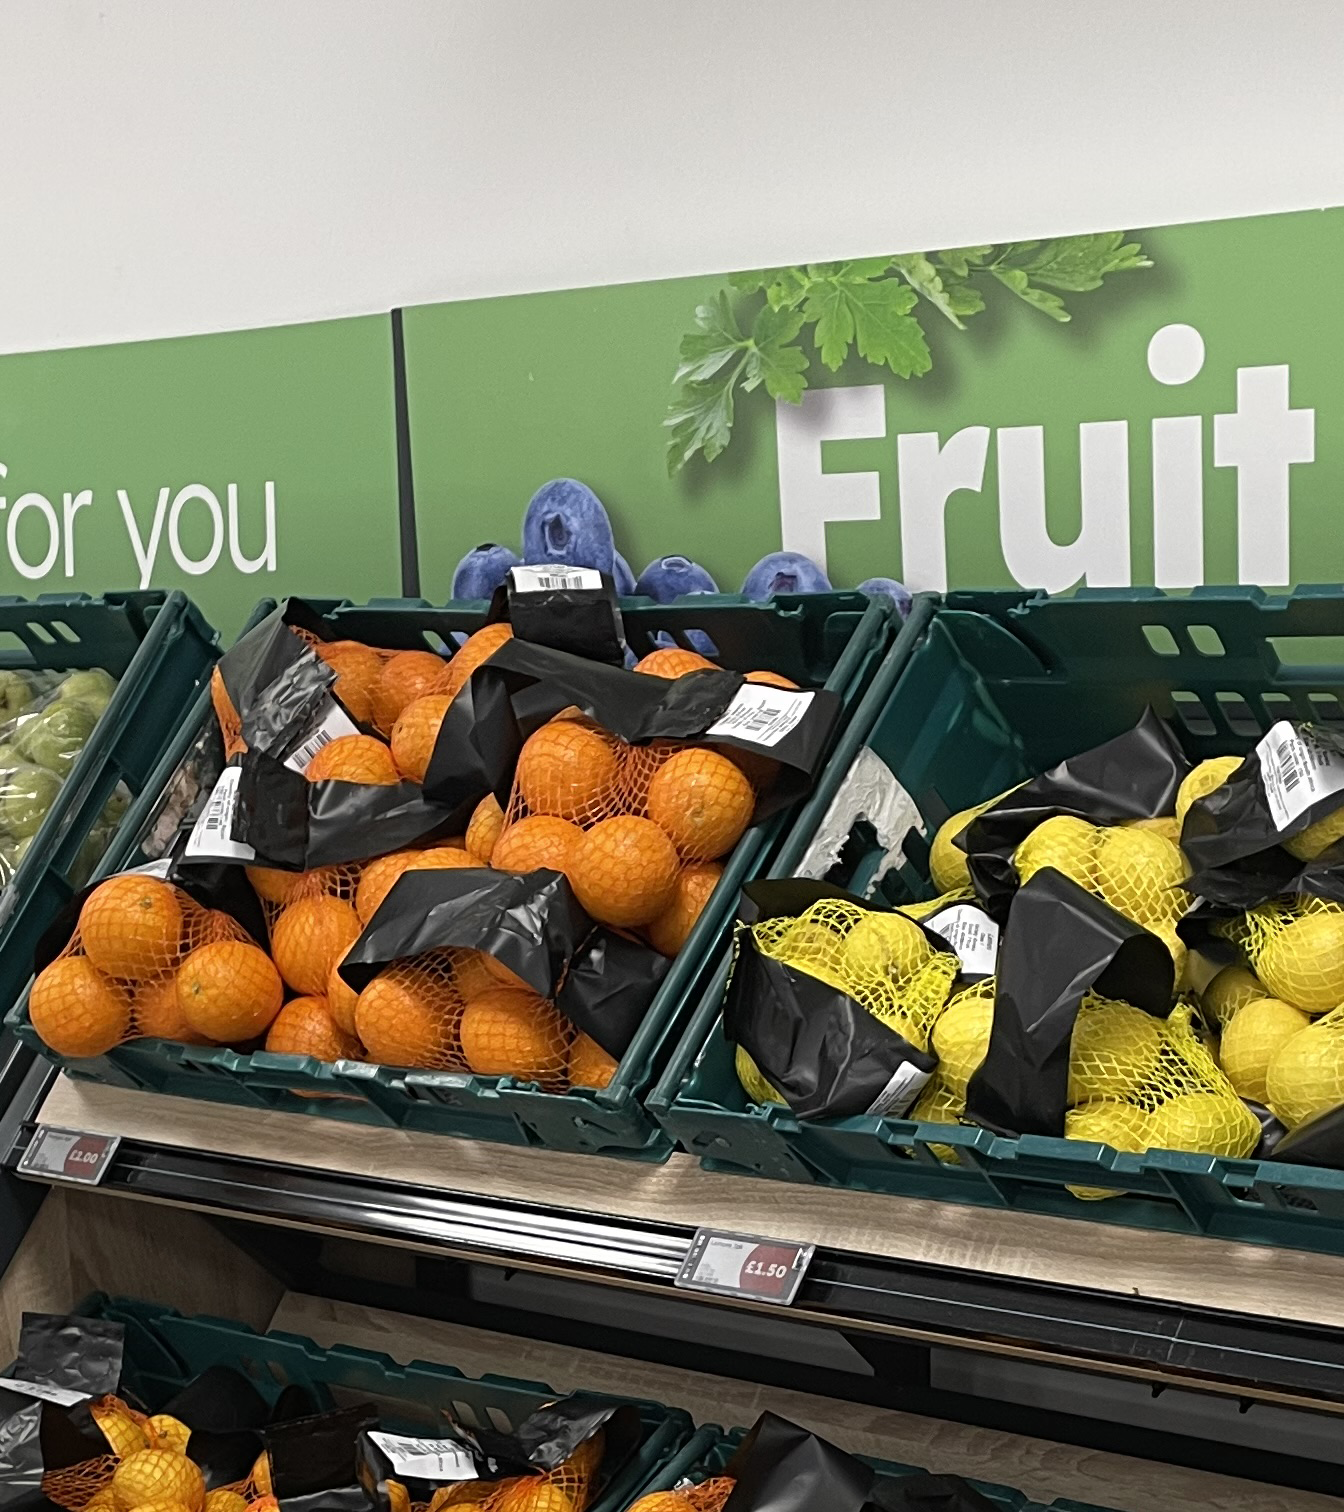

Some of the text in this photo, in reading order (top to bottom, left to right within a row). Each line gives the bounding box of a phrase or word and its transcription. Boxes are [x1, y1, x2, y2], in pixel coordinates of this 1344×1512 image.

[775, 324, 1315, 593] Fruit
[116, 480, 276, 590] you
[744, 1260, 787, 1279] £1.50
